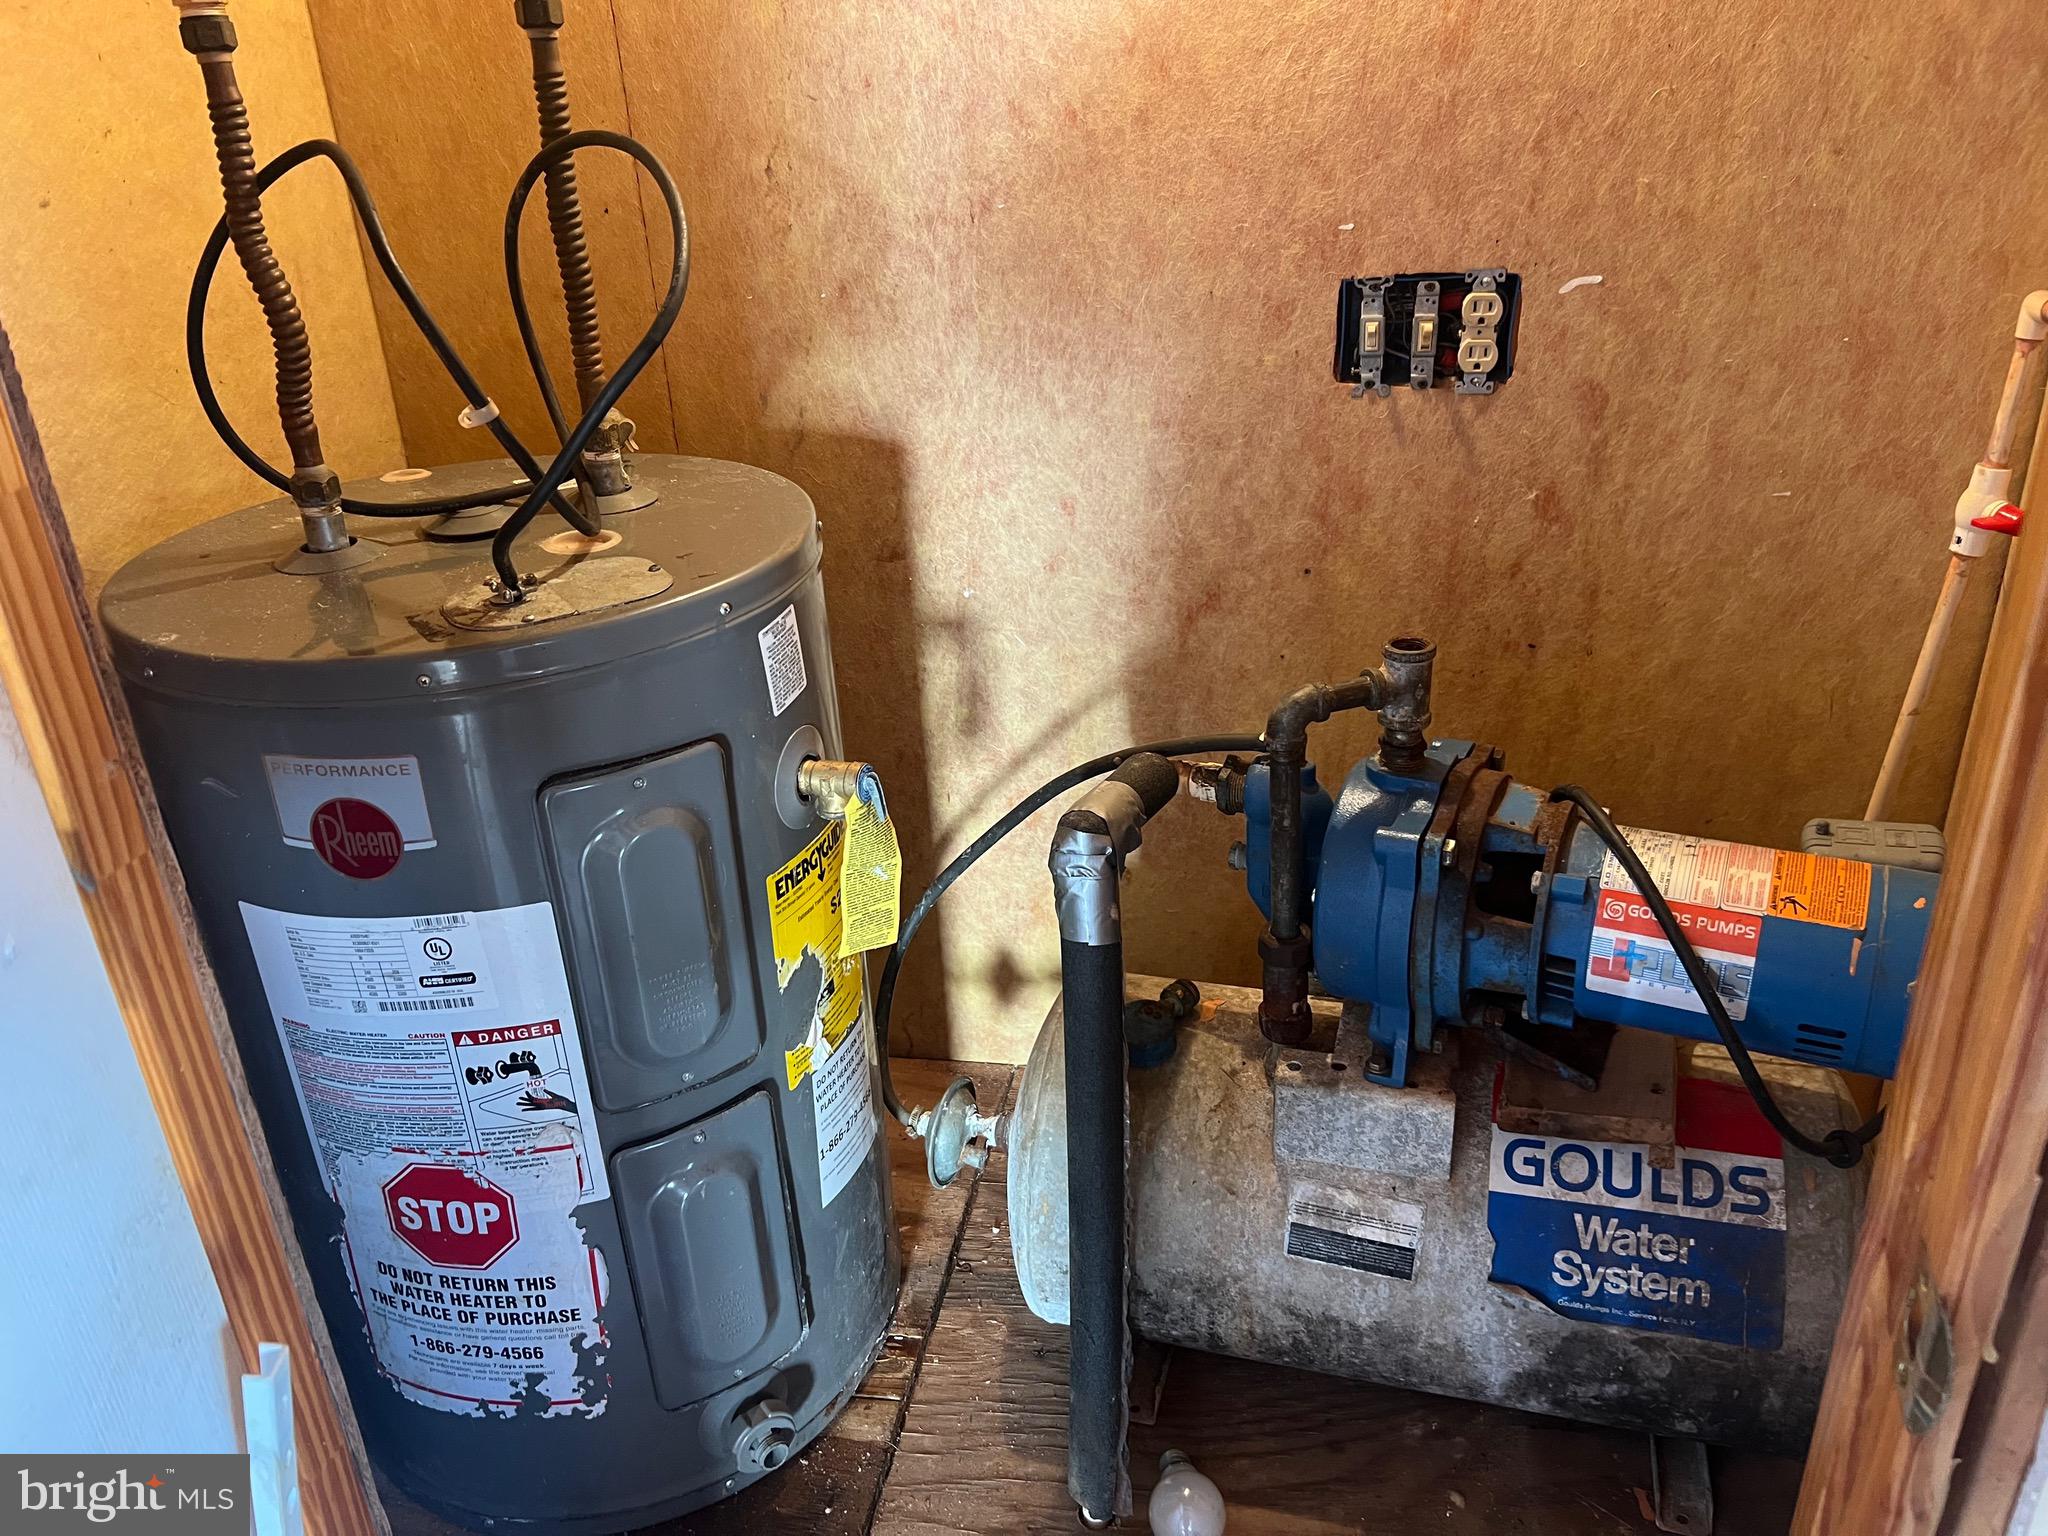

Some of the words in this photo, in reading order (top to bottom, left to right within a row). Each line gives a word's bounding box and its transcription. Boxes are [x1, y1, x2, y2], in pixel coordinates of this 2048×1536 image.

[271, 762, 411, 777] PERFORMANCE
[317, 801, 399, 867] Rheem
[1696, 917, 1756, 939] PUMPS
[429, 943, 446, 955] UL
[478, 1023, 554, 1043] DANGER
[526, 1079, 548, 1088] HOT
[815, 1079, 837, 1103] WATER
[837, 1055, 854, 1082] HEATER
[816, 1075, 826, 1088] DO
[827, 1060, 839, 1078] NOT
[820, 1089, 838, 1113] PLACE
[838, 1080, 846, 1094] OF
[1503, 1138, 1771, 1215] GOULDS
[397, 1196, 500, 1235] STOP
[1573, 1212, 1696, 1264] Water
[377, 1260, 397, 1279] DO
[402, 1267, 433, 1286] NOT
[439, 1275, 509, 1292] RETURN
[514, 1276, 556, 1292] THIS
[1552, 1250, 1711, 1307] System
[370, 1287, 398, 1309] THE
[402, 1299, 453, 1322] PLACE
[457, 1310, 479, 1324] OF
[485, 1307, 581, 1326] PURCHASE
[390, 1280, 445, 1304] WATER
[450, 1293, 517, 1309] HEATER
[523, 1294, 547, 1309] TO
[410, 1334, 544, 1360] 1-866-279-4566
